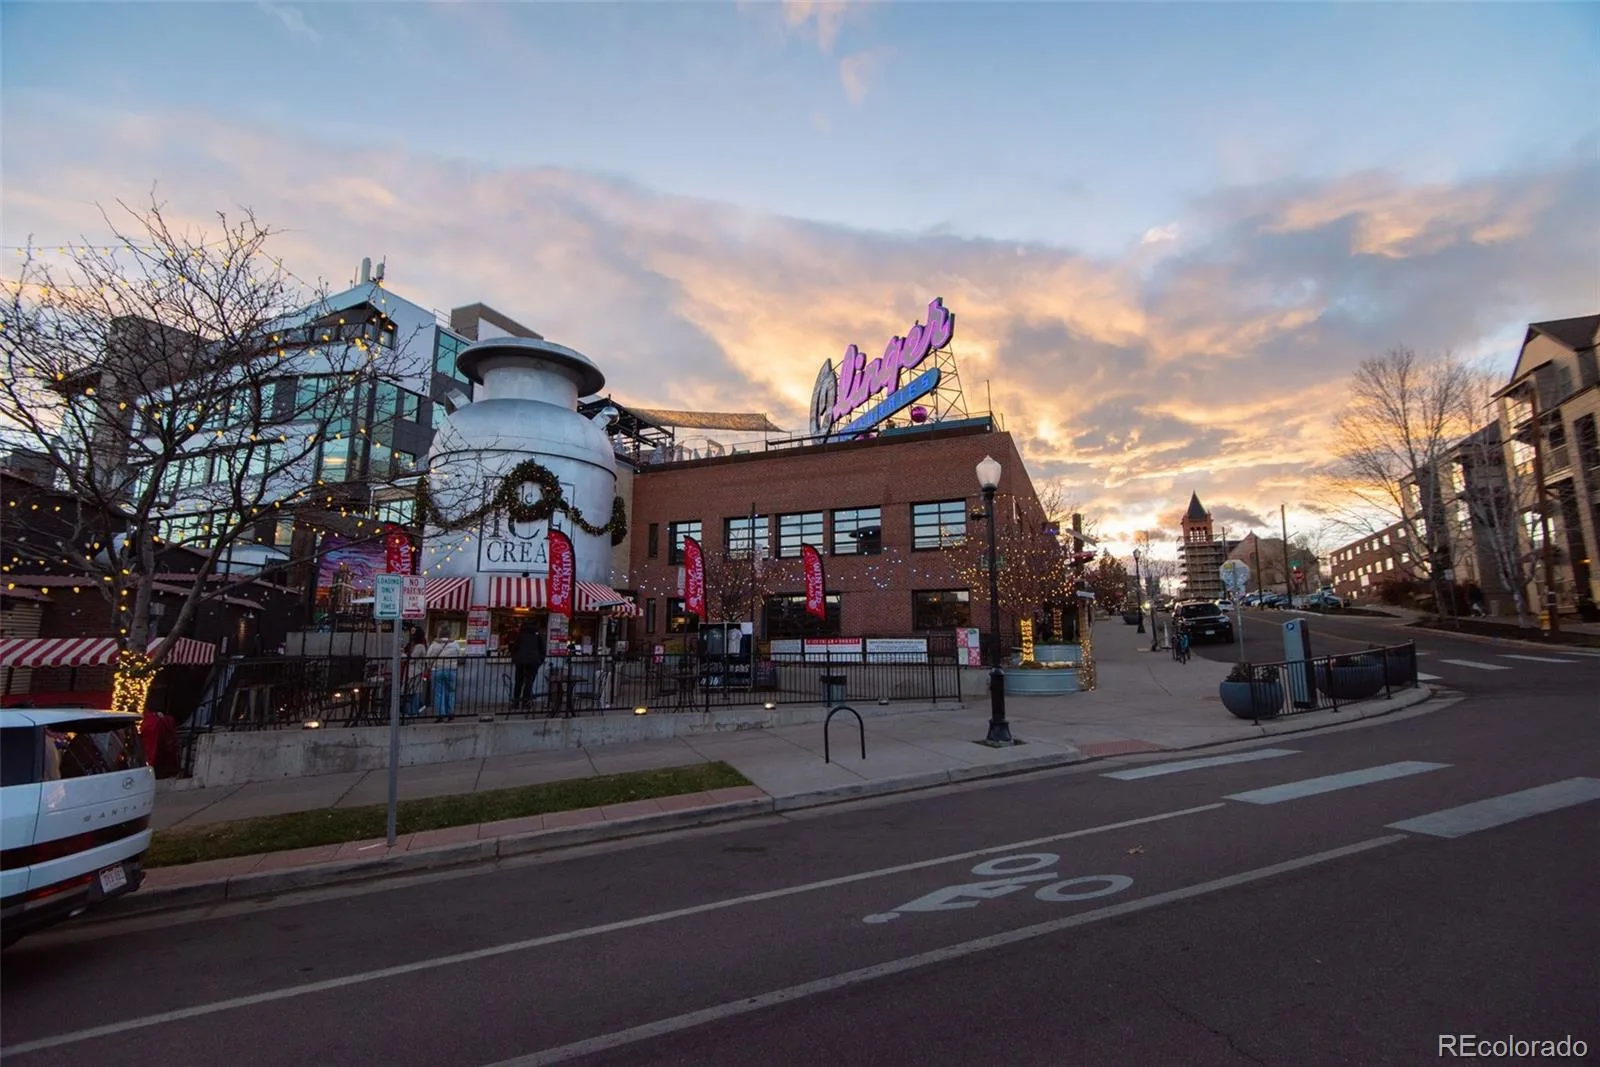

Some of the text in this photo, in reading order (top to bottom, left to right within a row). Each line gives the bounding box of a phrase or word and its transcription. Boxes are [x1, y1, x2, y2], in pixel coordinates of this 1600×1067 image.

[486, 541, 548, 564] CREA
[403, 586, 424, 595] PARKING
[409, 578, 419, 587] NO
[560, 551, 572, 600] WINTER
[694, 556, 704, 601] WINTER
[813, 562, 823, 604] WINTER
